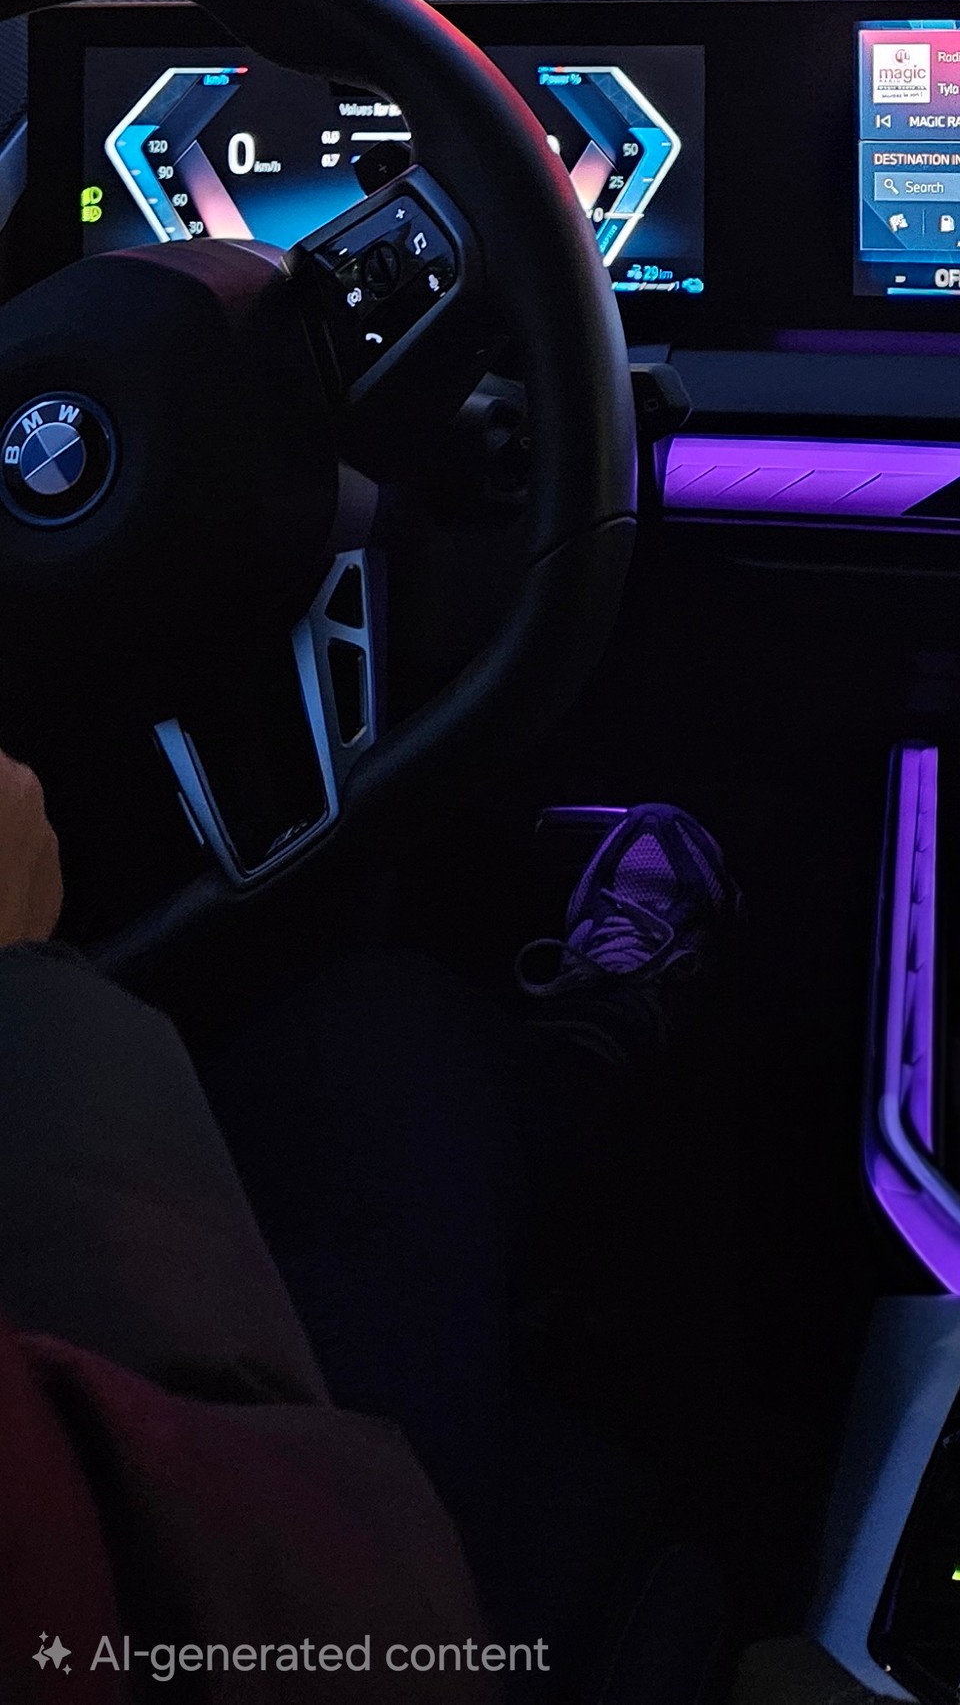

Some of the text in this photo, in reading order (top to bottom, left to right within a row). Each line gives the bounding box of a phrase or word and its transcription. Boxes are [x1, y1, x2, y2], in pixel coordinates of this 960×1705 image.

[879, 65, 926, 83] magic
[938, 83, 959, 96] Tyla
[909, 116, 945, 129] MAGIC
[149, 140, 168, 153] 120
[227, 132, 255, 175] 0
[622, 143, 639, 157] 50
[874, 153, 949, 166] DESTINATION
[157, 166, 174, 179] 90
[608, 175, 624, 190] 25
[905, 180, 944, 194] Search
[172, 194, 188, 207] 60
[593, 207, 604, 222] 0
[188, 221, 204, 234] 30
[643, 265, 673, 280] 29 km
[5, 404, 80, 464] BMW
